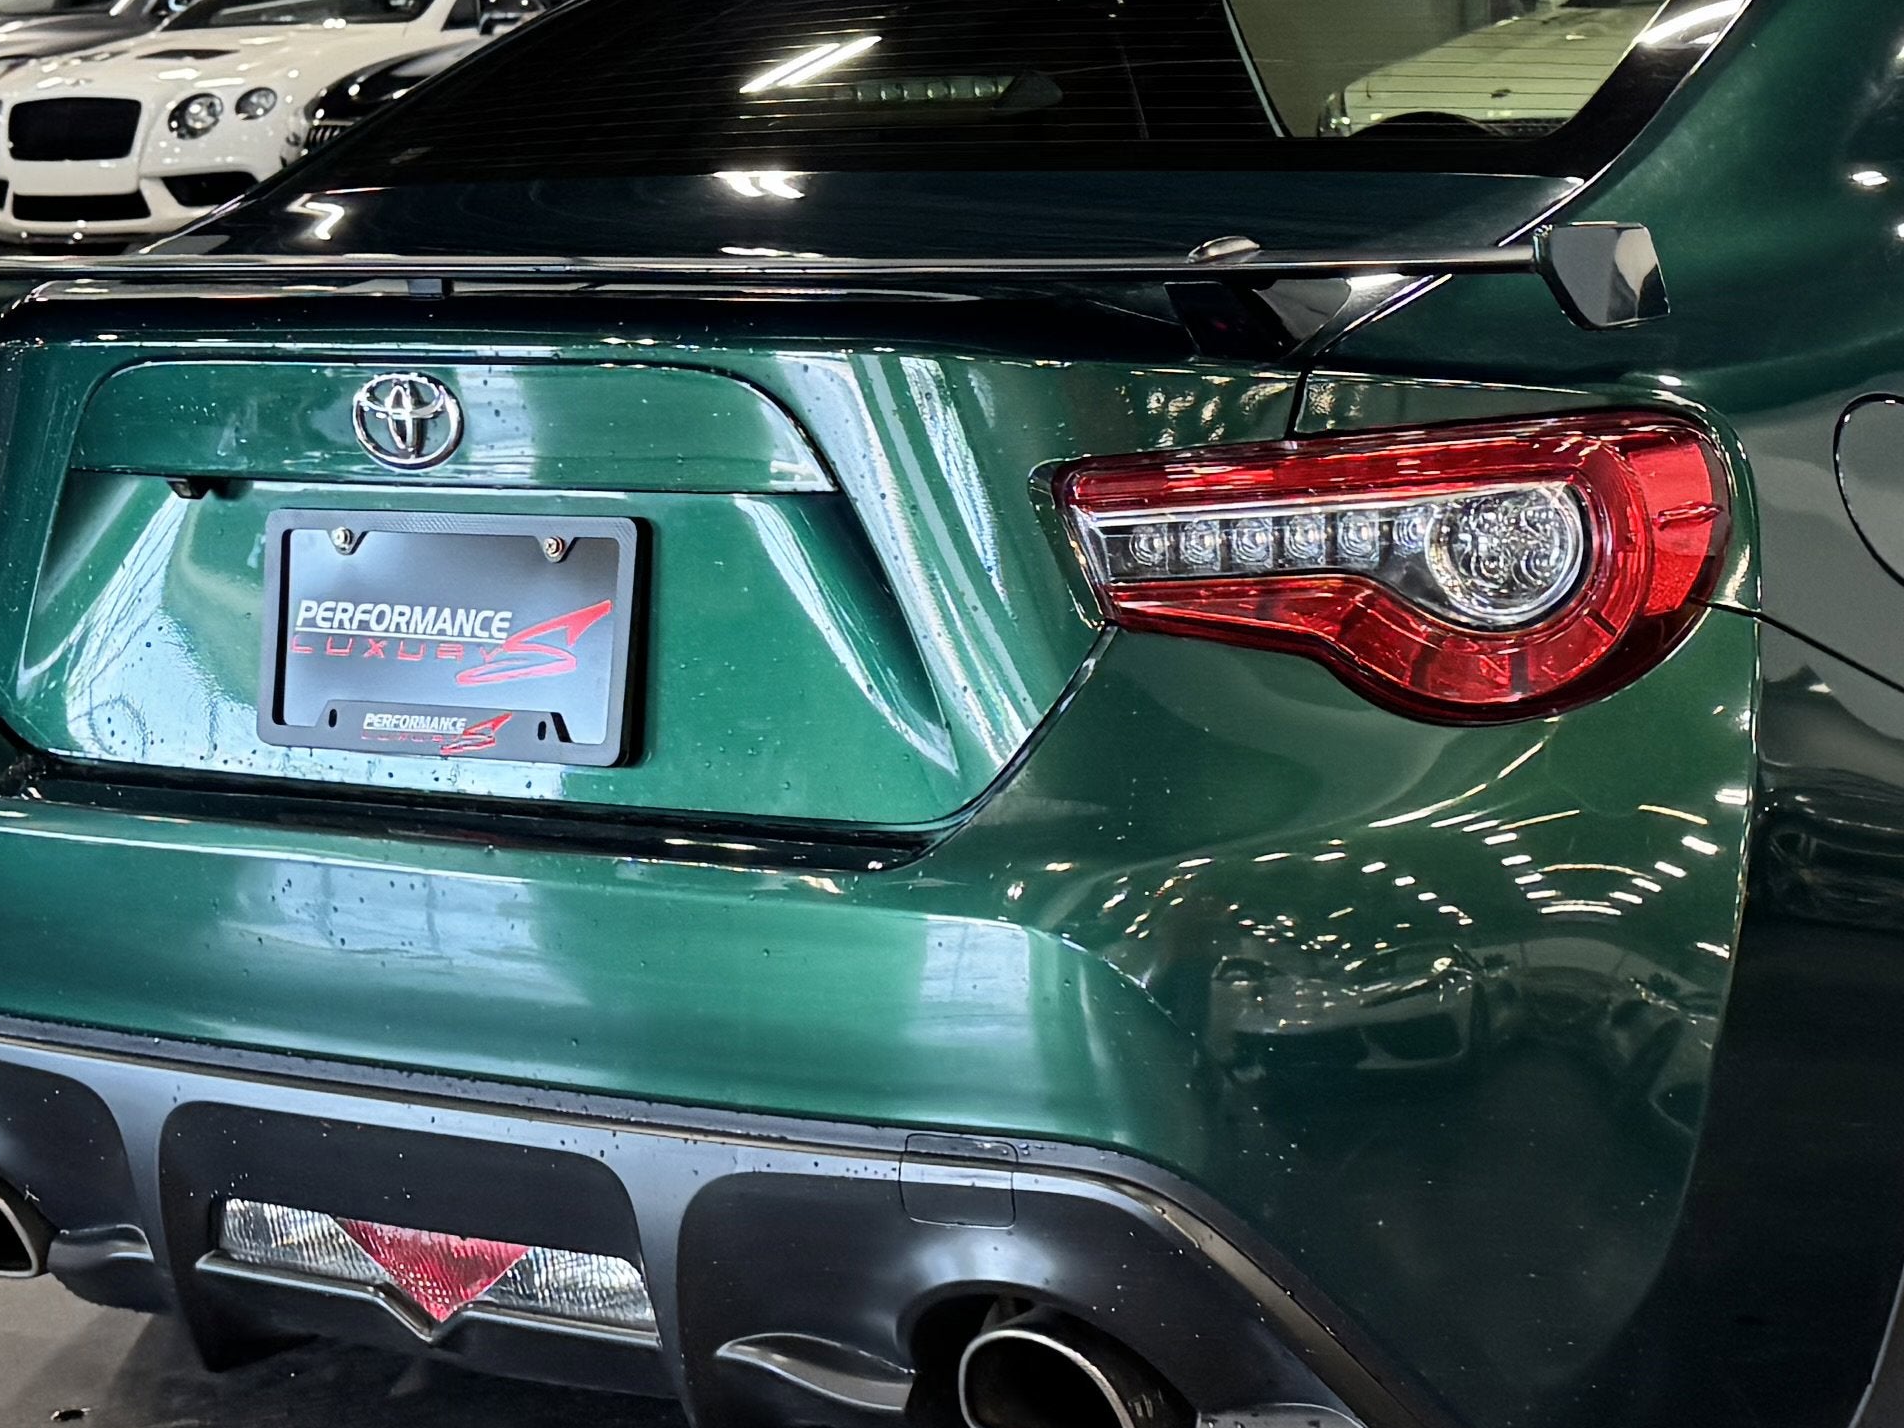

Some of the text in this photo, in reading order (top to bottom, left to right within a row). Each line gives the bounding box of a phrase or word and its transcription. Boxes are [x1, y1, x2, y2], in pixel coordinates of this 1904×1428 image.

[295, 600, 512, 638] PERFORMANCE
[291, 635, 503, 662] LUXURY
[363, 713, 467, 732] PERFORMANCE
